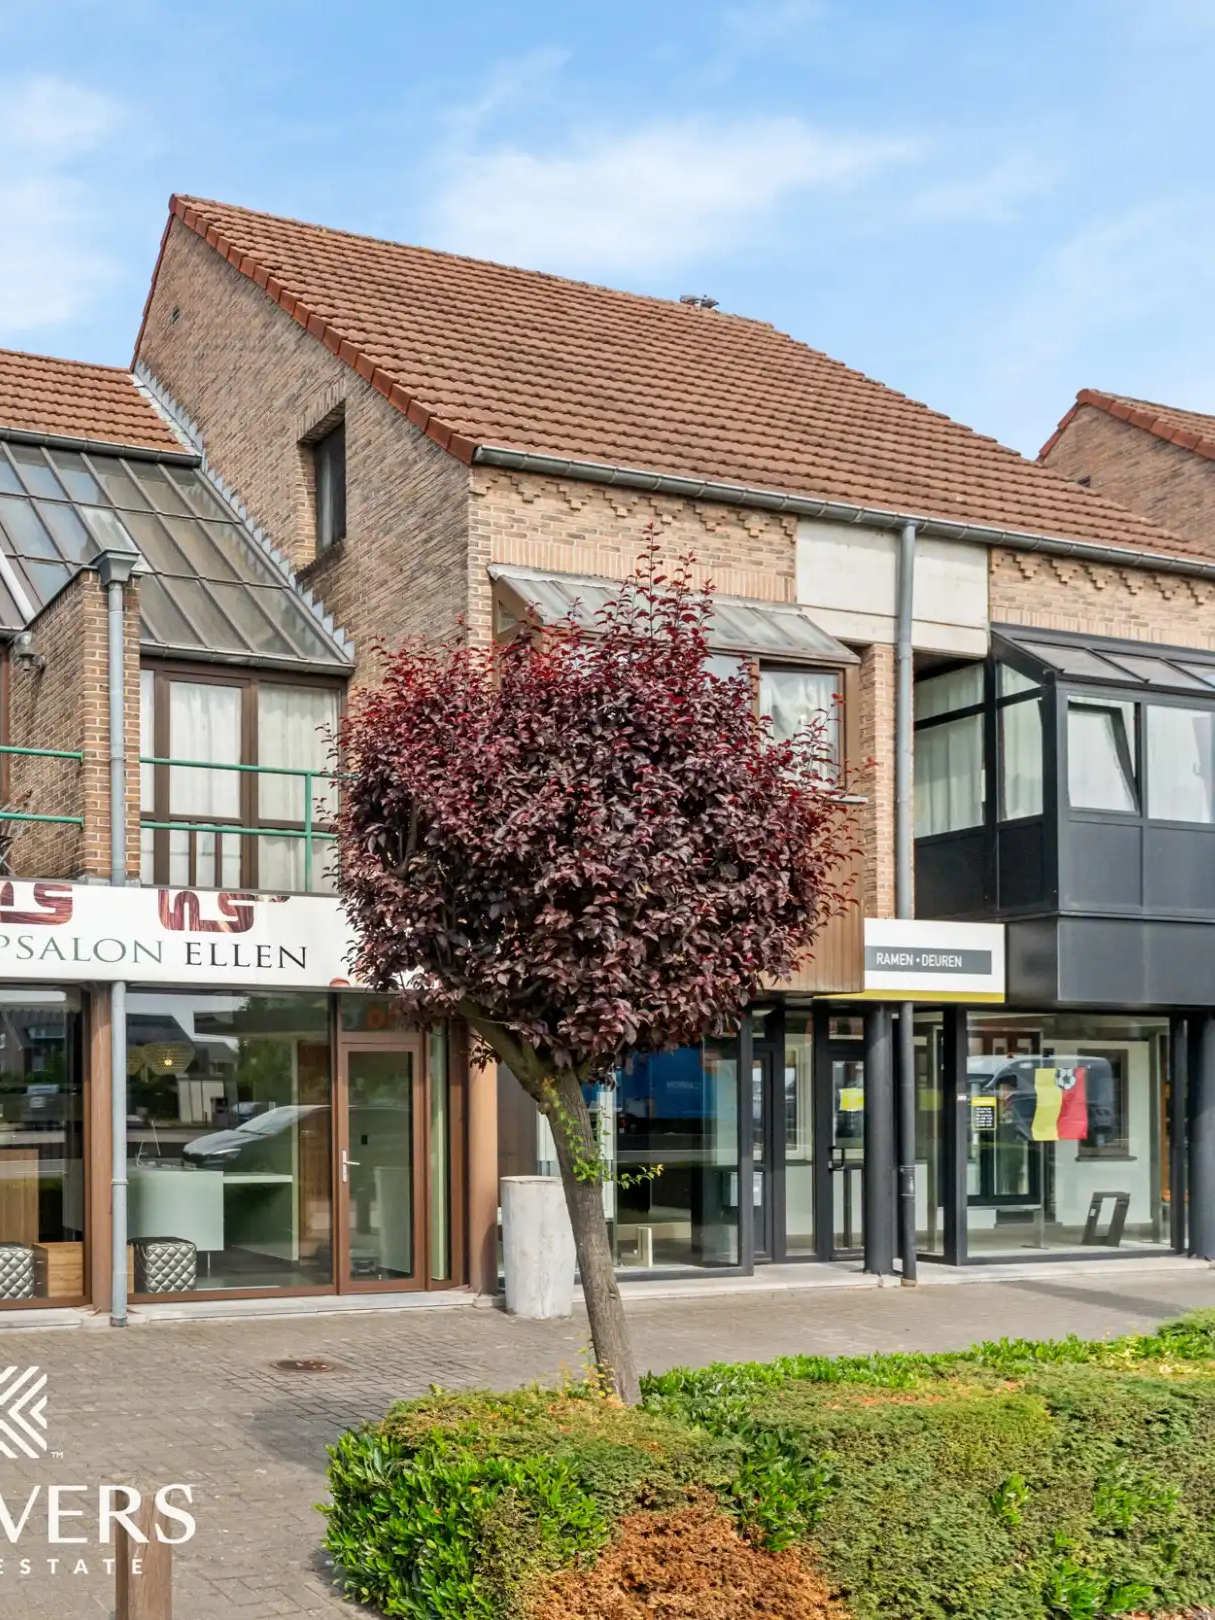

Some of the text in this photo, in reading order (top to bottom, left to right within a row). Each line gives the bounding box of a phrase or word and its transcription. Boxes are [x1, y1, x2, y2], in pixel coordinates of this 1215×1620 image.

[184, 941, 308, 970] ELLEN
[876, 952, 963, 968] RAMEN DEUREN
